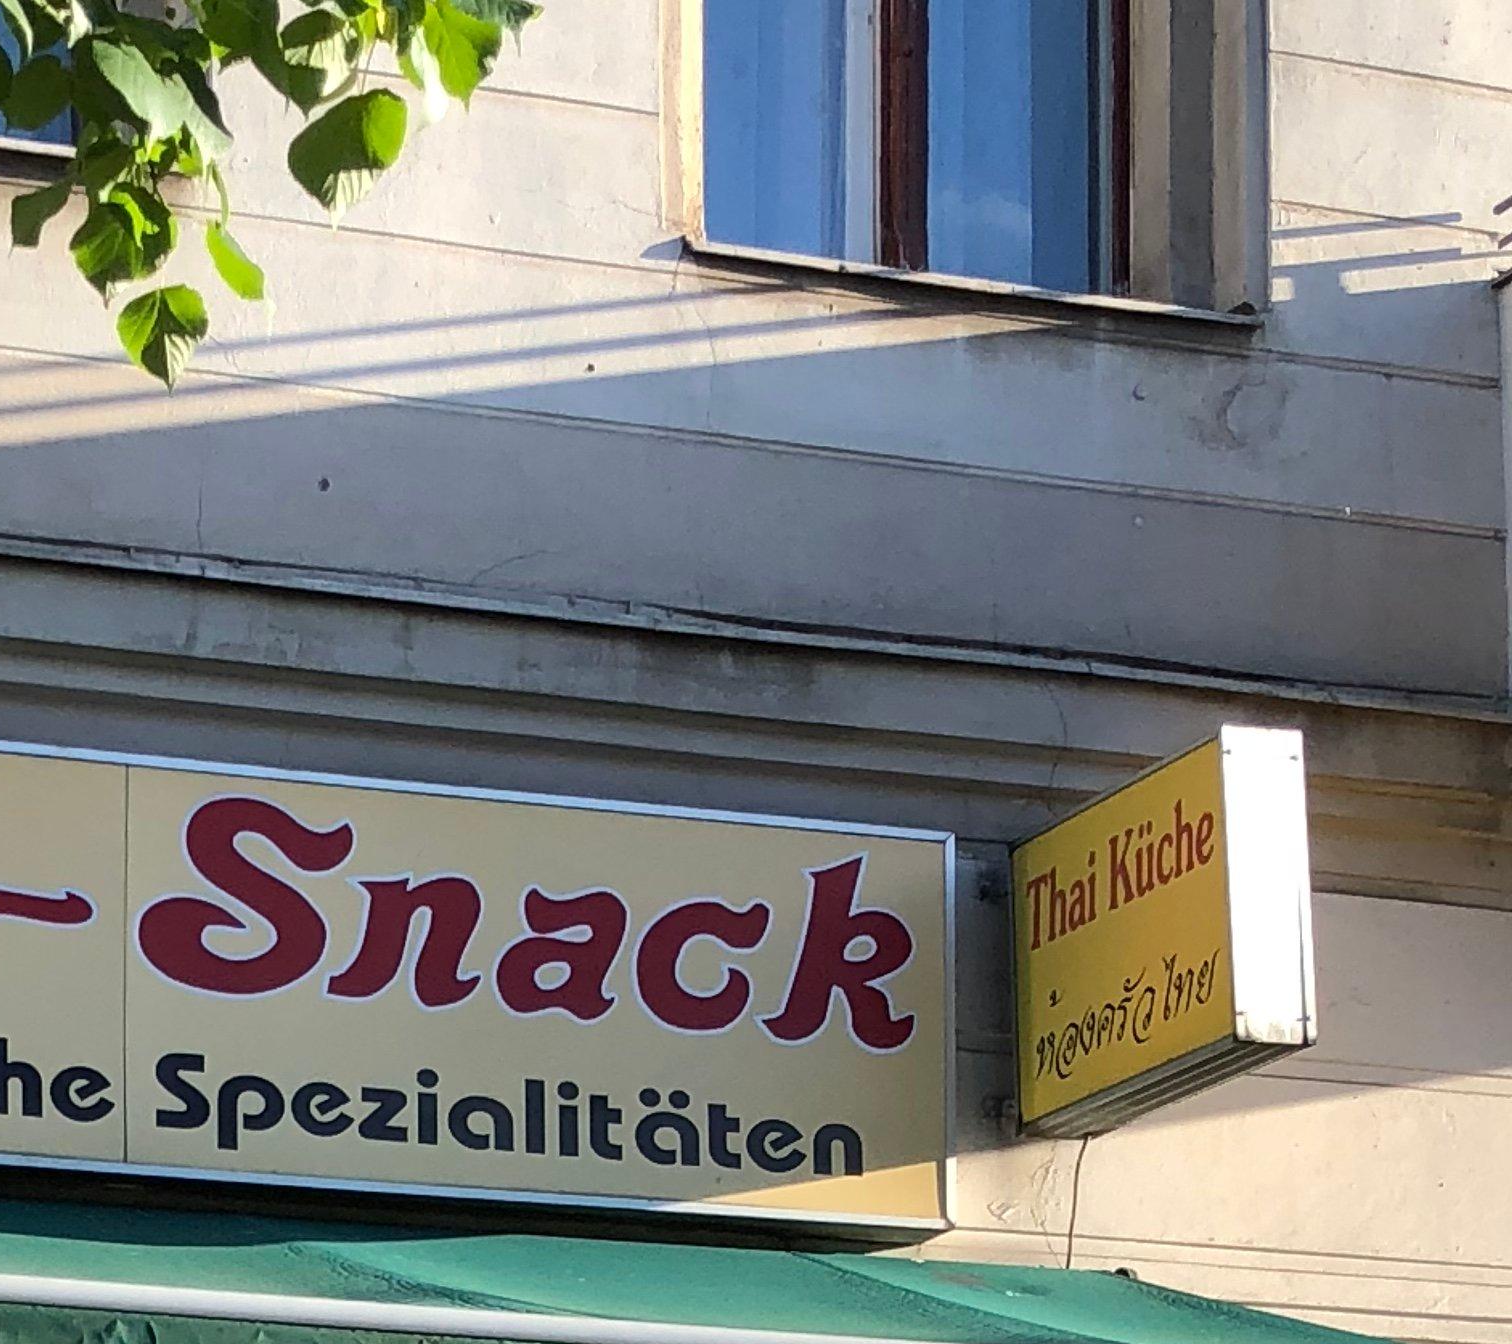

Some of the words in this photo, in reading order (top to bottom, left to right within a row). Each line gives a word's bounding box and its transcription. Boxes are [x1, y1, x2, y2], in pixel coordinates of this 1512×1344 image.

[136, 795, 915, 1052] Snack
[1027, 851, 1098, 951] Thai
[1108, 798, 1215, 911] Küche
[155, 1053, 863, 1176] Spezialitäten
